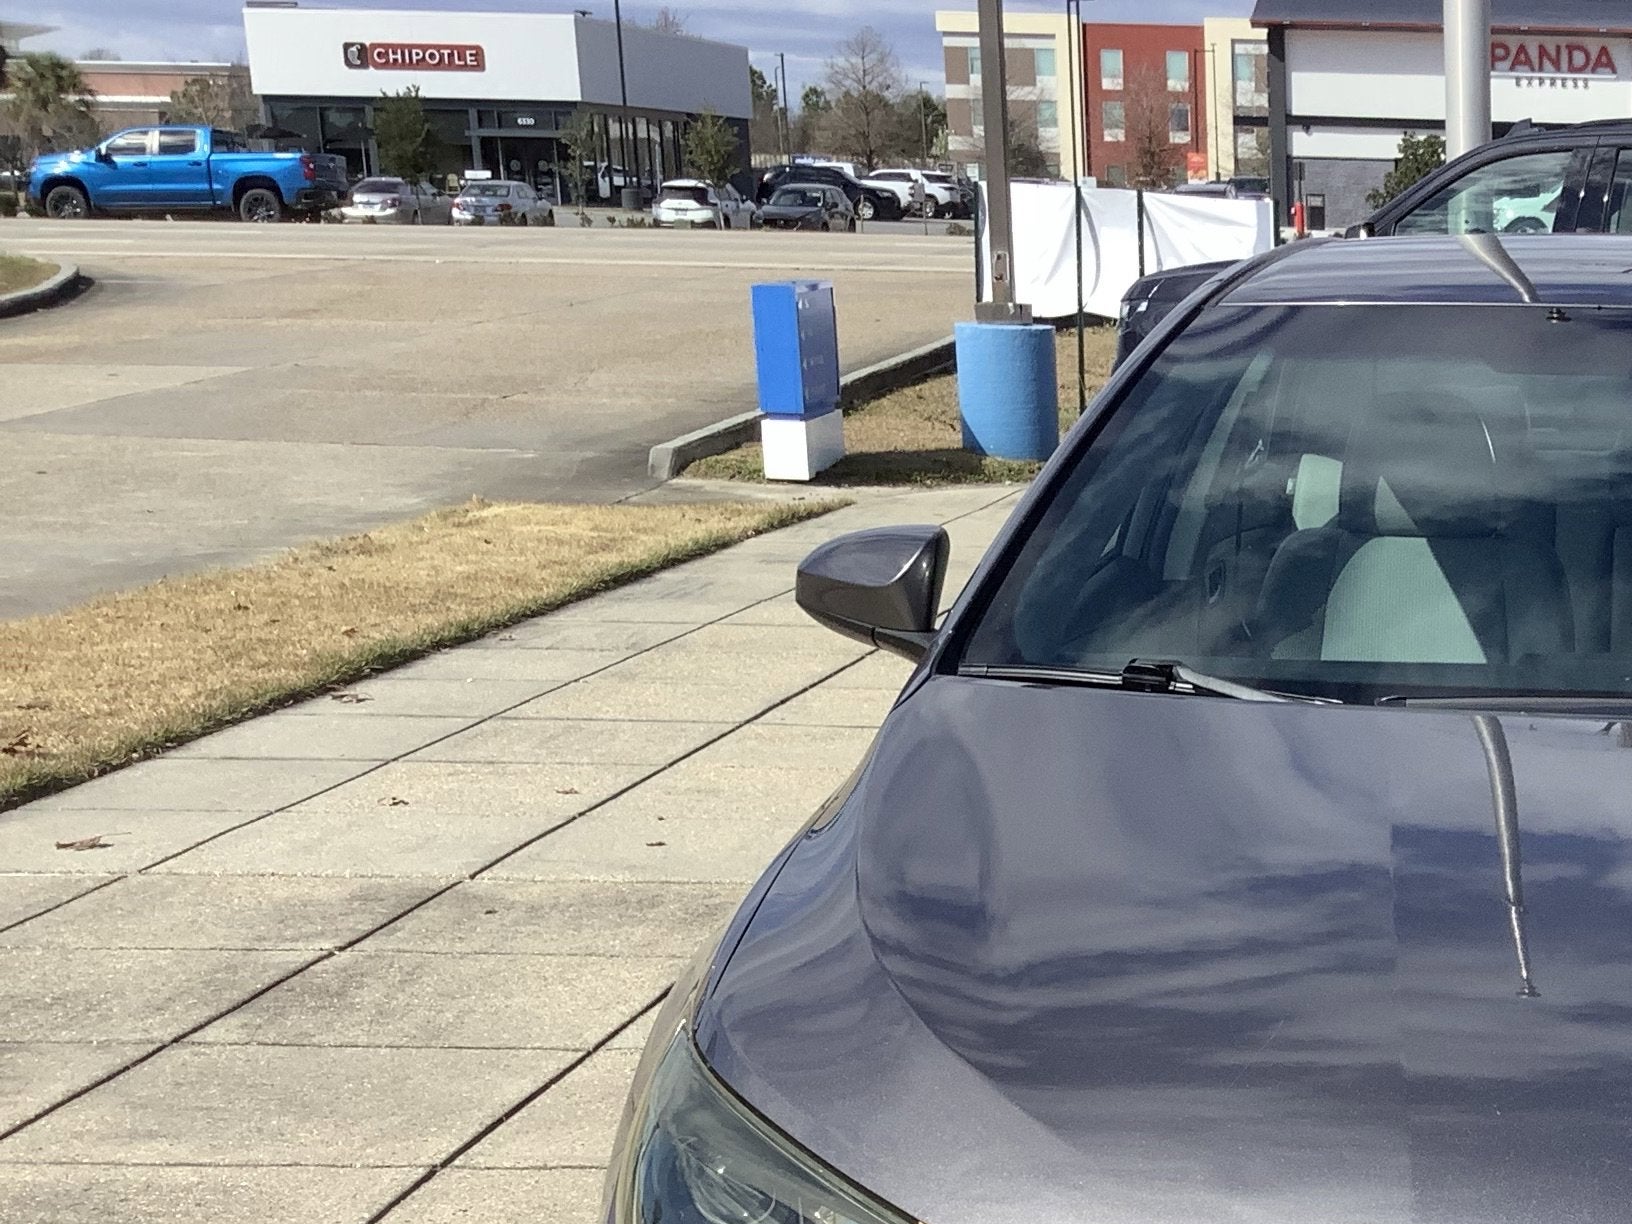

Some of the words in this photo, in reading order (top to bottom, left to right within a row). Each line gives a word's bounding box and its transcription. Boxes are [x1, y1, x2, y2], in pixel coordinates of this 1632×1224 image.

[373, 47, 479, 66] CHIPOTLE
[1491, 42, 1618, 74] PANDA
[1515, 77, 1590, 89] EXPRESS
